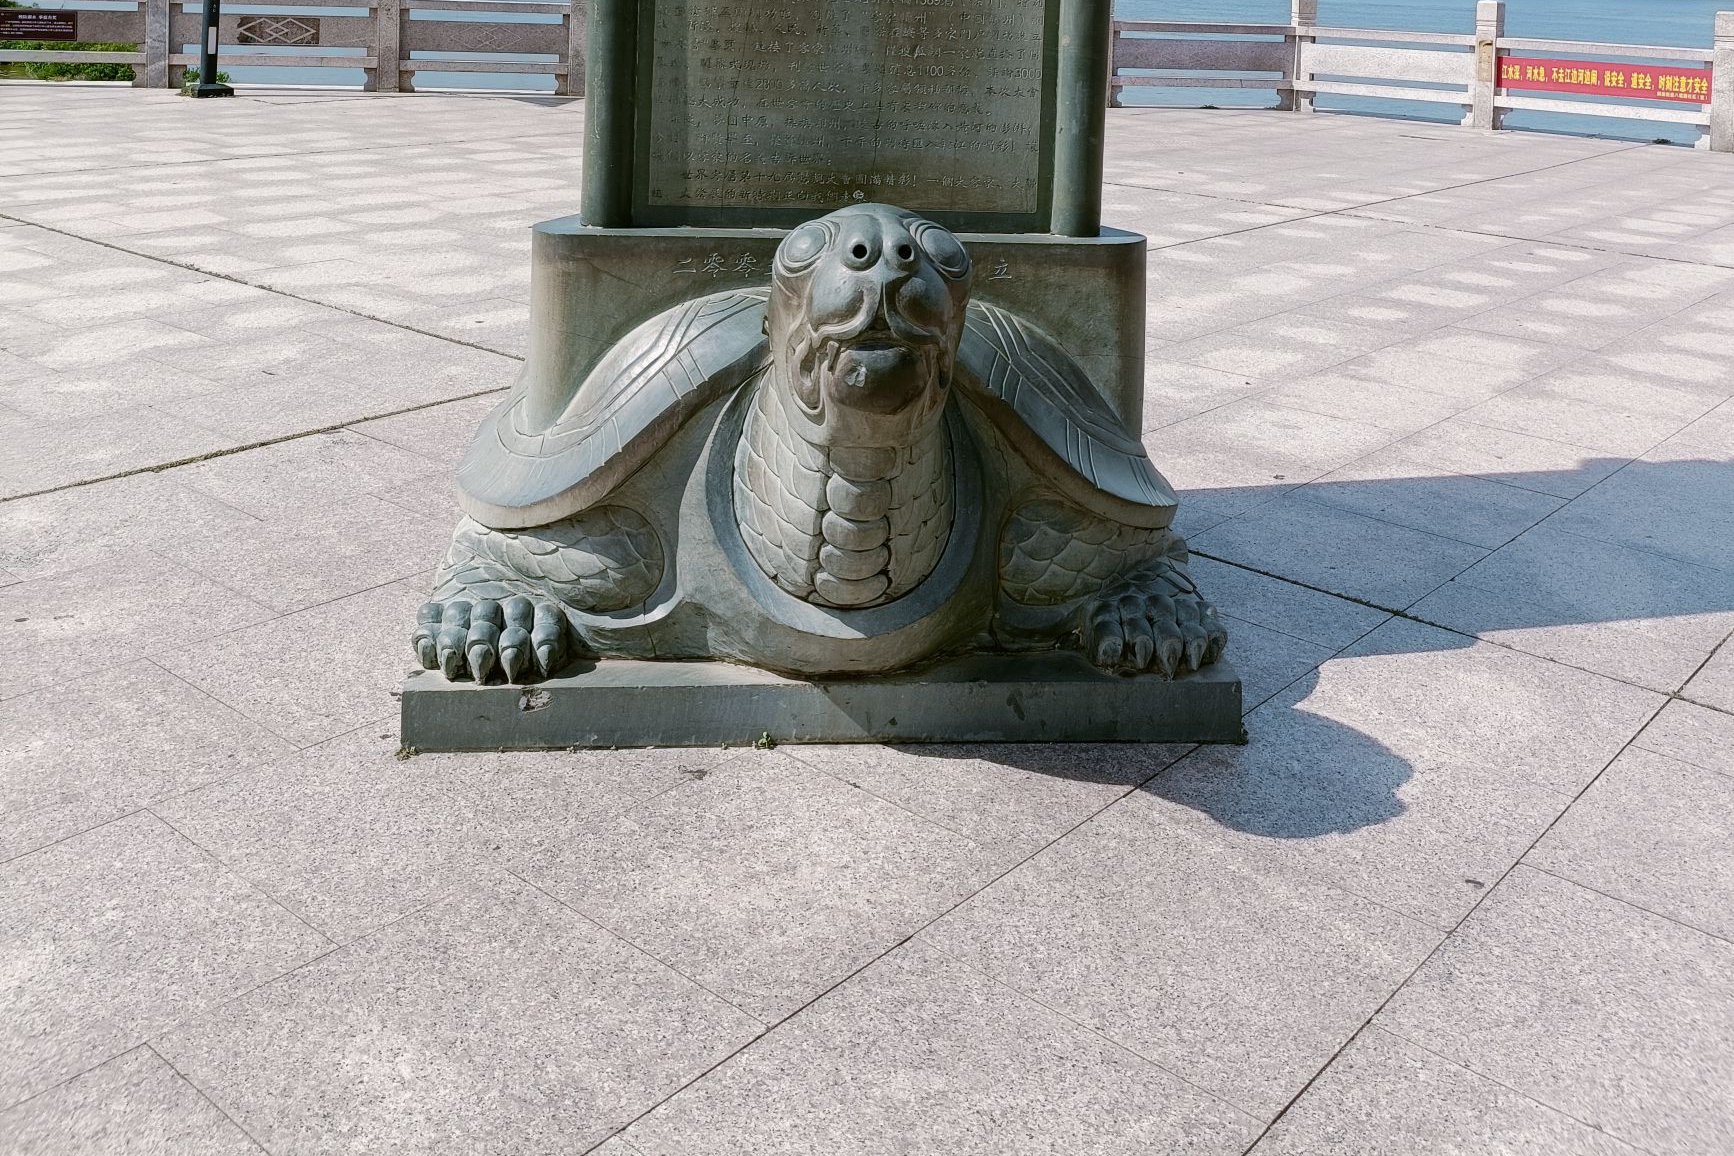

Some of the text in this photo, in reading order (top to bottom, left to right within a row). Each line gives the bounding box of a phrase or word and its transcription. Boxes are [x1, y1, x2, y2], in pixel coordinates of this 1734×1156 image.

[672, 251, 774, 278] 二零零
[988, 257, 1012, 280] 立
